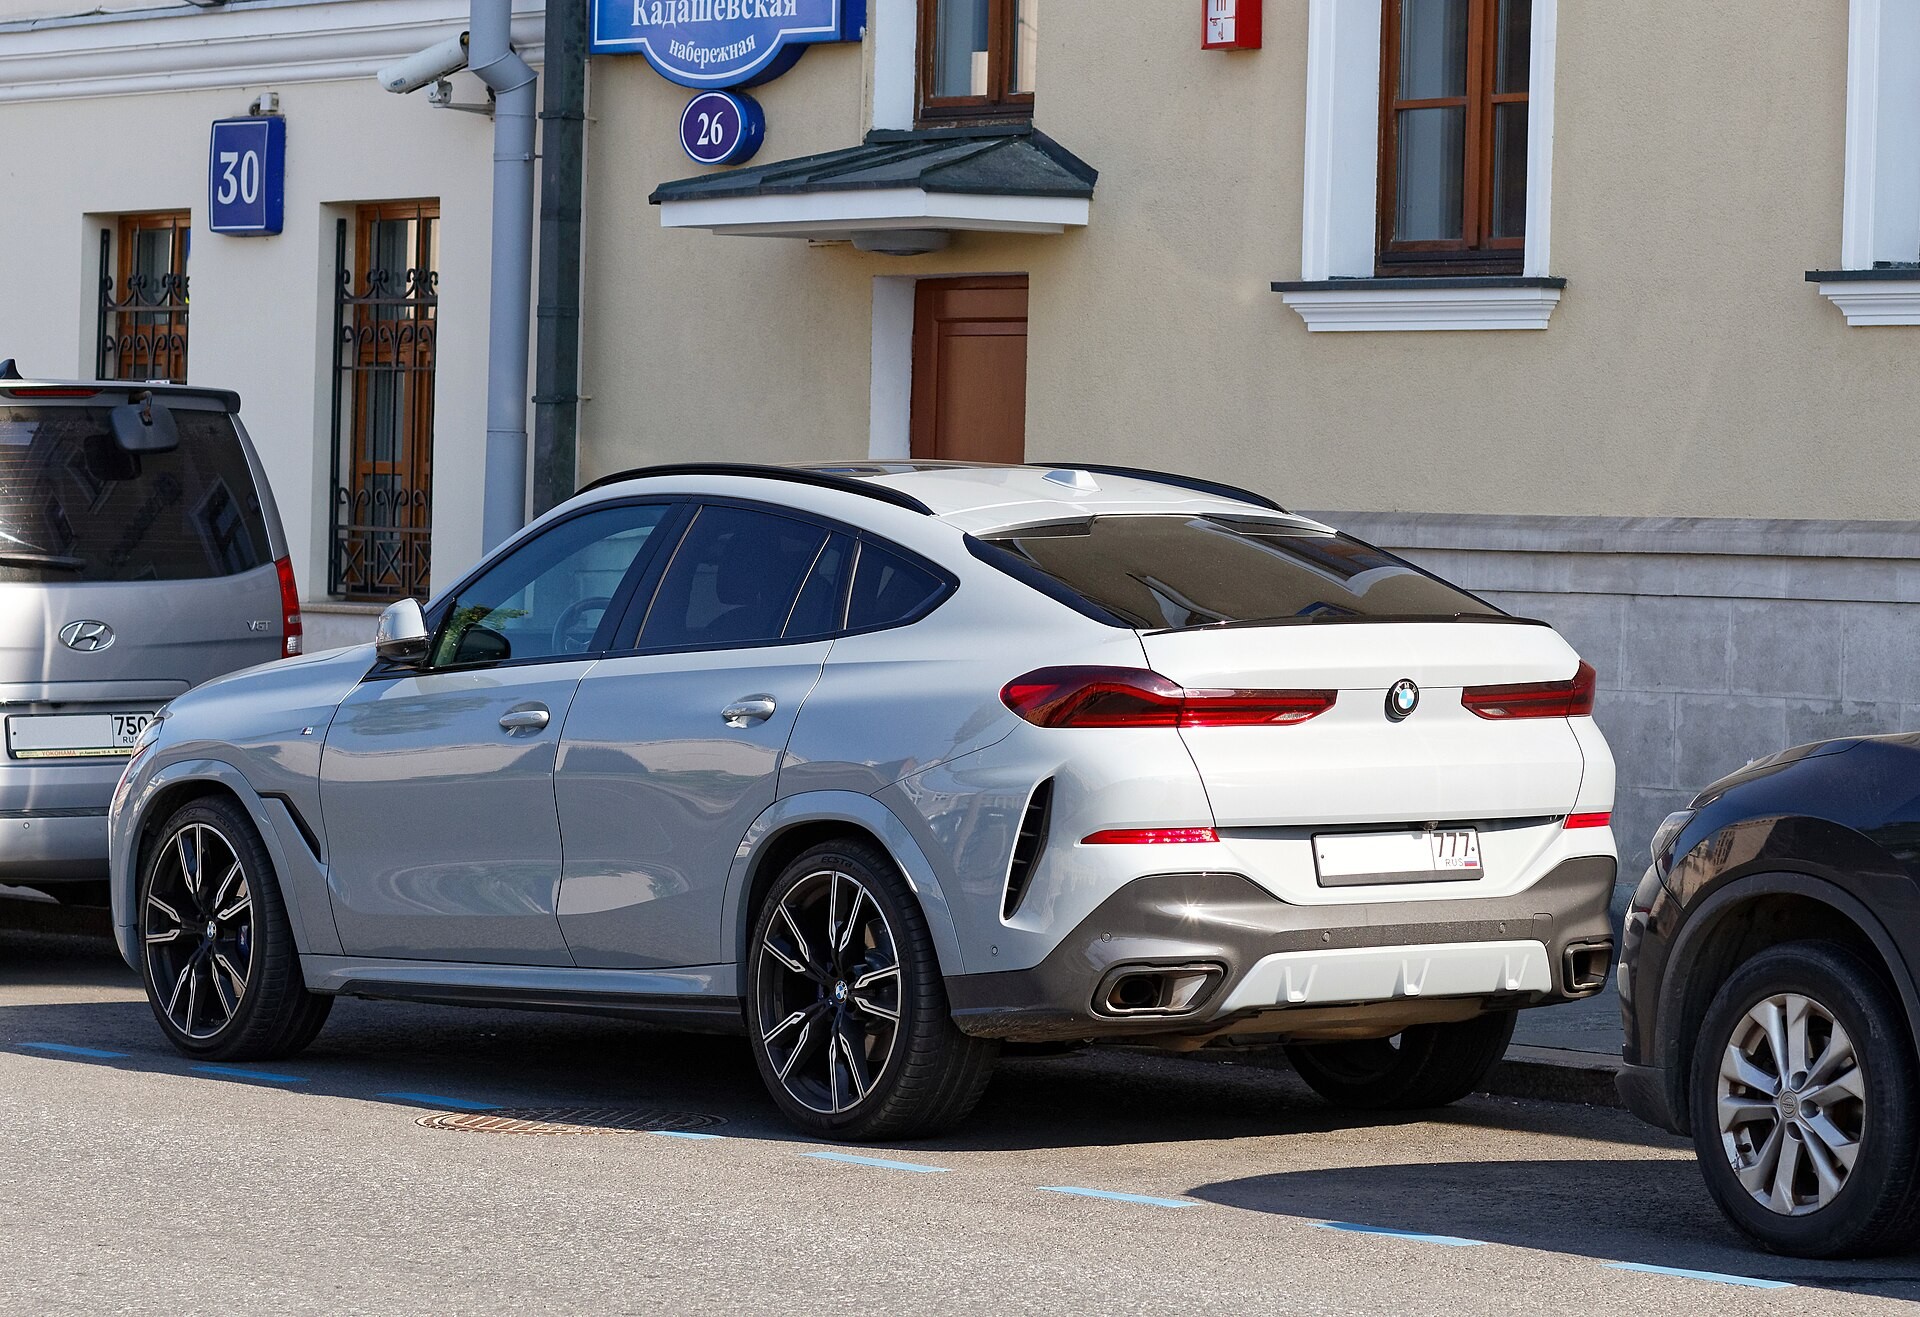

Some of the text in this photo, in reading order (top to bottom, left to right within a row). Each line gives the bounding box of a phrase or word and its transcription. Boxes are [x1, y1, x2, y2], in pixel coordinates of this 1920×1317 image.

[631, 0, 797, 29] Кадашевская
[669, 34, 756, 69] набережная
[696, 111, 723, 146] 26
[218, 150, 259, 205] 30
[114, 716, 148, 736] 750
[1434, 832, 1469, 857] 777
[1445, 858, 1464, 867] RUS
